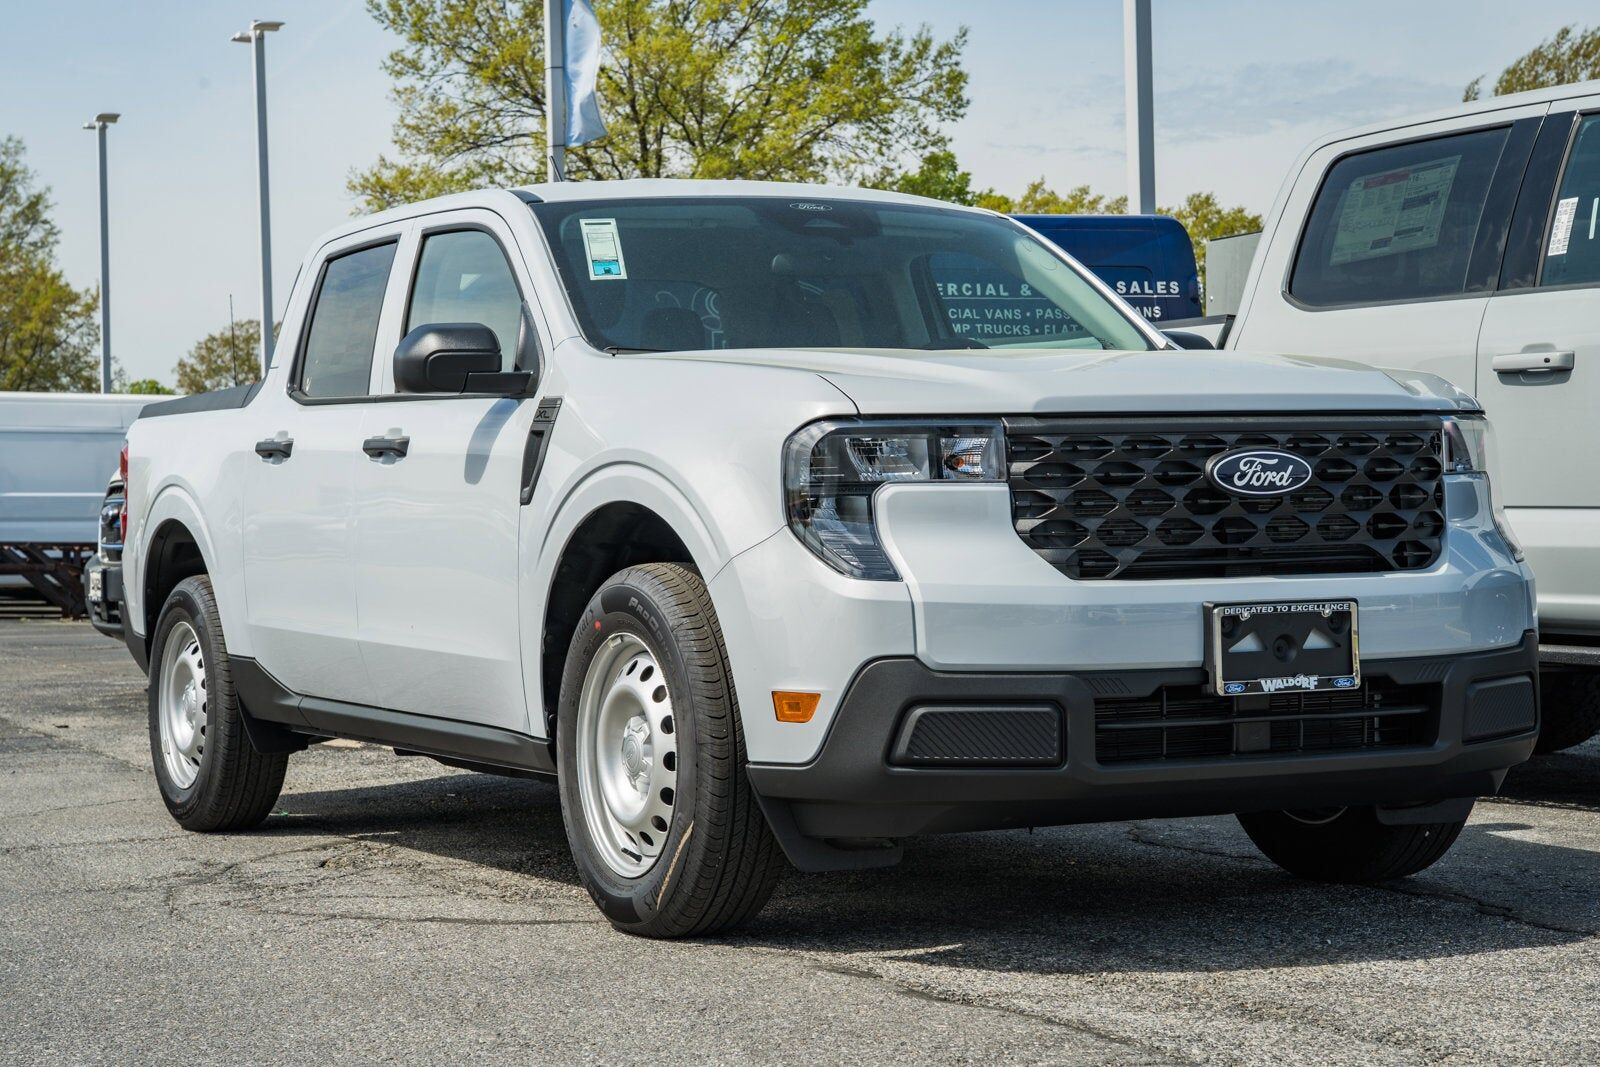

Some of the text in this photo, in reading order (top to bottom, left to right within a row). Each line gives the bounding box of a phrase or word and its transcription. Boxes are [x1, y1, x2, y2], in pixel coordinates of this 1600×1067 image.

[1020, 283, 1032, 296] &
[1116, 281, 1180, 294] SALES
[948, 308, 980, 319] CIAL
[985, 308, 1022, 320] VANS
[975, 323, 1031, 335] TRUCKS
[536, 410, 550, 418] XL
[1233, 457, 1294, 487] Ford
[1225, 606, 1274, 615] DEDICATED
[1291, 603, 1350, 612] EXCELLENCE
[1260, 675, 1319, 692] WALDORF
